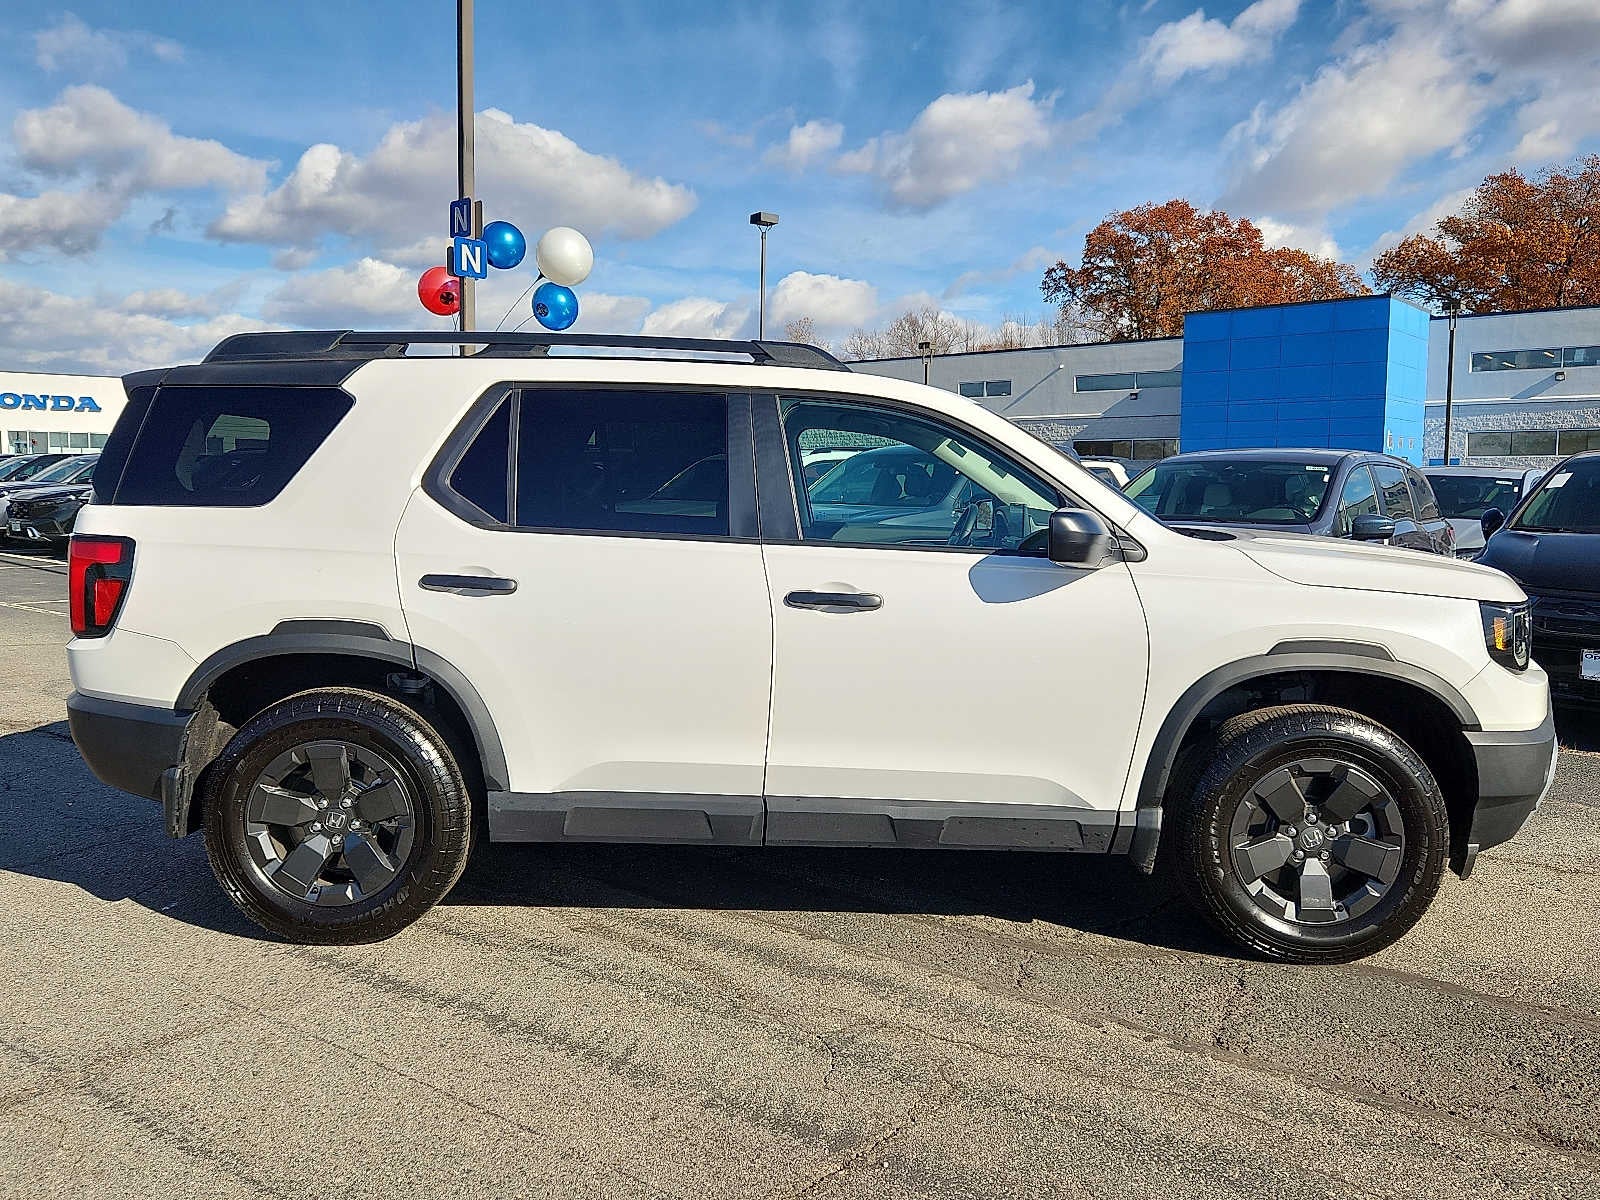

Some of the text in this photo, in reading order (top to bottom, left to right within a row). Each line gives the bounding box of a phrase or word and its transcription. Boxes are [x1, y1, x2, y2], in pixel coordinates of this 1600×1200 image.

[454, 205, 468, 234] N
[461, 243, 481, 274] N
[0, 392, 102, 413] ONDA
